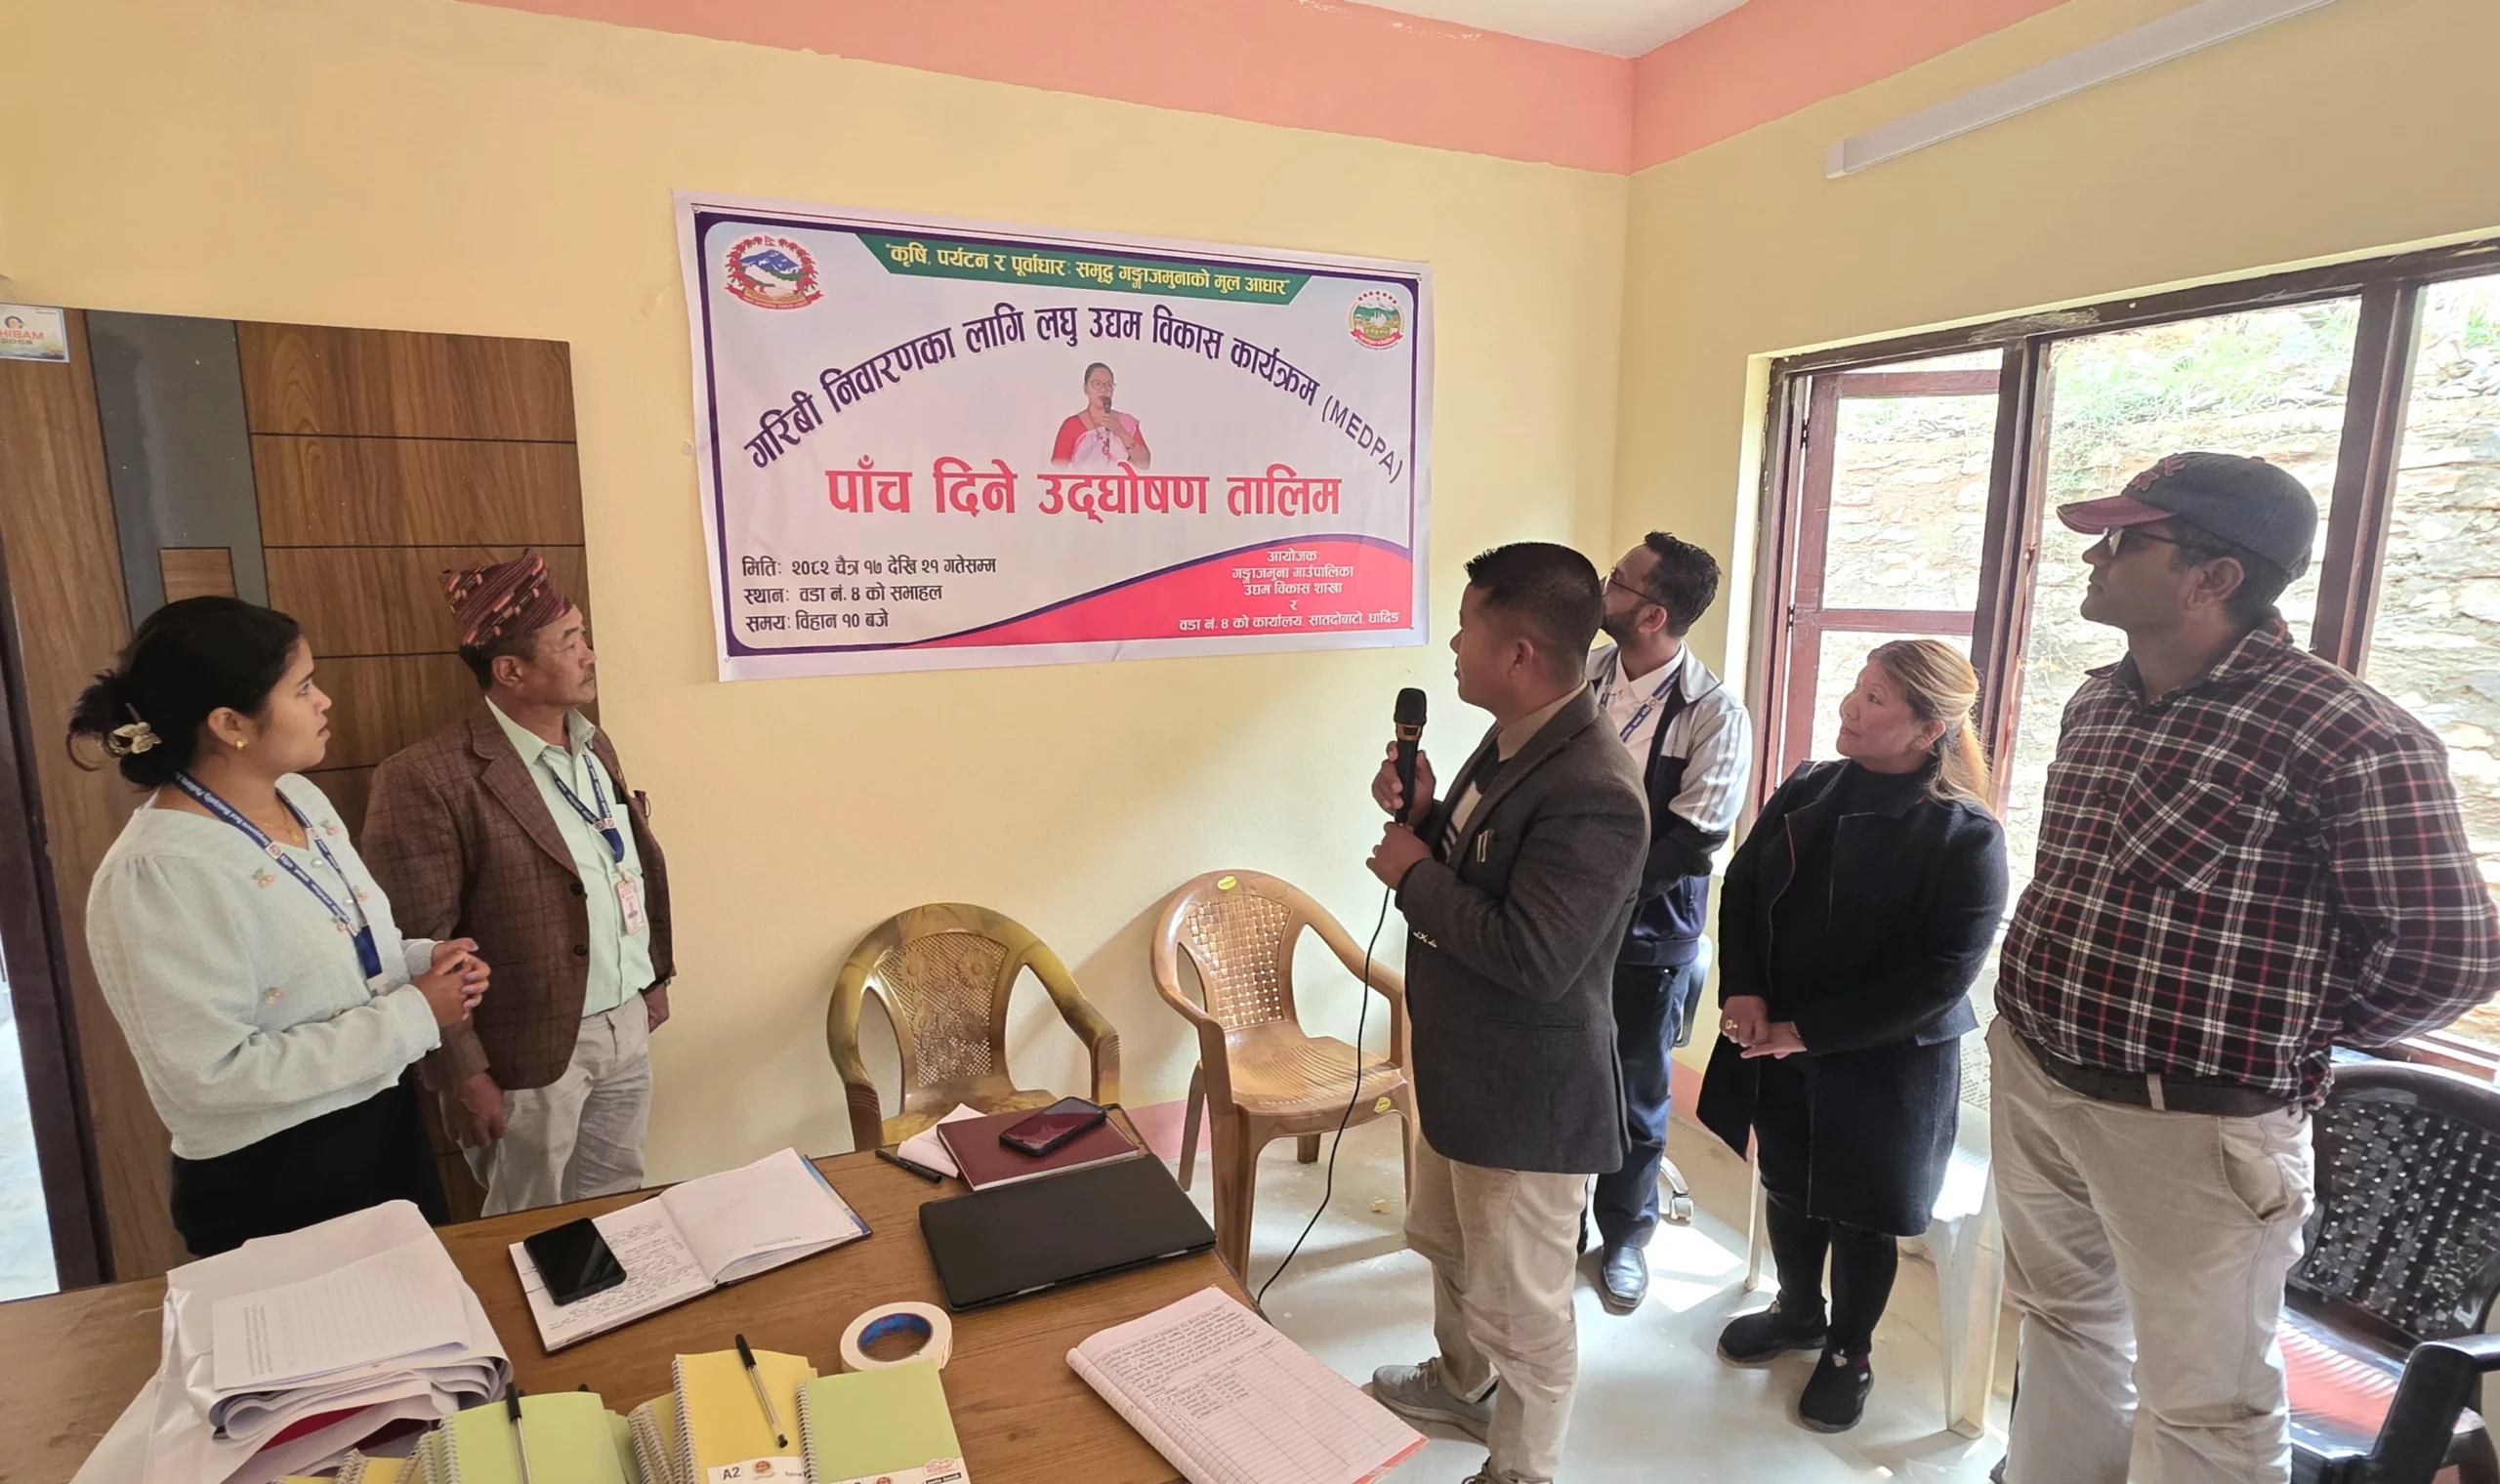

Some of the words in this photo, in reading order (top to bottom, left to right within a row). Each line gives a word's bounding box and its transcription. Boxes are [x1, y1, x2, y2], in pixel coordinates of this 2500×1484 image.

[937, 248, 989, 269] पर्यटन
[994, 254, 1006, 270] र
[1214, 273, 1240, 293] मुल
[743, 390, 823, 469] गरिबी
[819, 327, 956, 414] निवारणका
[961, 302, 1026, 353] लागि
[1034, 307, 1077, 347] लघु
[1088, 307, 1142, 341] उद्यम
[1152, 304, 1224, 359] विकास
[1230, 337, 1320, 406] कार्यक्रम
[1321, 394, 1403, 483] (MEDPA)
[825, 454, 912, 514] पाँच
[933, 456, 1018, 517] दिने
[1227, 463, 1343, 517] तालिम
[792, 560, 829, 575] २०८२
[835, 555, 859, 576] चैत्र
[863, 559, 883, 574] १७
[888, 555, 917, 575] देखि
[921, 558, 938, 574] २१
[943, 554, 997, 574] गतेसम्म
[1267, 548, 1318, 562] आयोजक
[800, 588, 825, 602] वडा
[865, 581, 885, 601] को
[890, 585, 942, 601] सभाहल
[1243, 583, 1271, 597] उद्यम
[1273, 581, 1311, 596] विकास
[1313, 582, 1344, 595] शाखा
[1289, 599, 1299, 611] र
[795, 609, 838, 631] विहान
[842, 613, 859, 629] १०
[865, 607, 890, 628] बजे
[1179, 618, 1201, 632] वडा
[1232, 614, 1249, 630] को
[723, 1466, 741, 1480] A2
